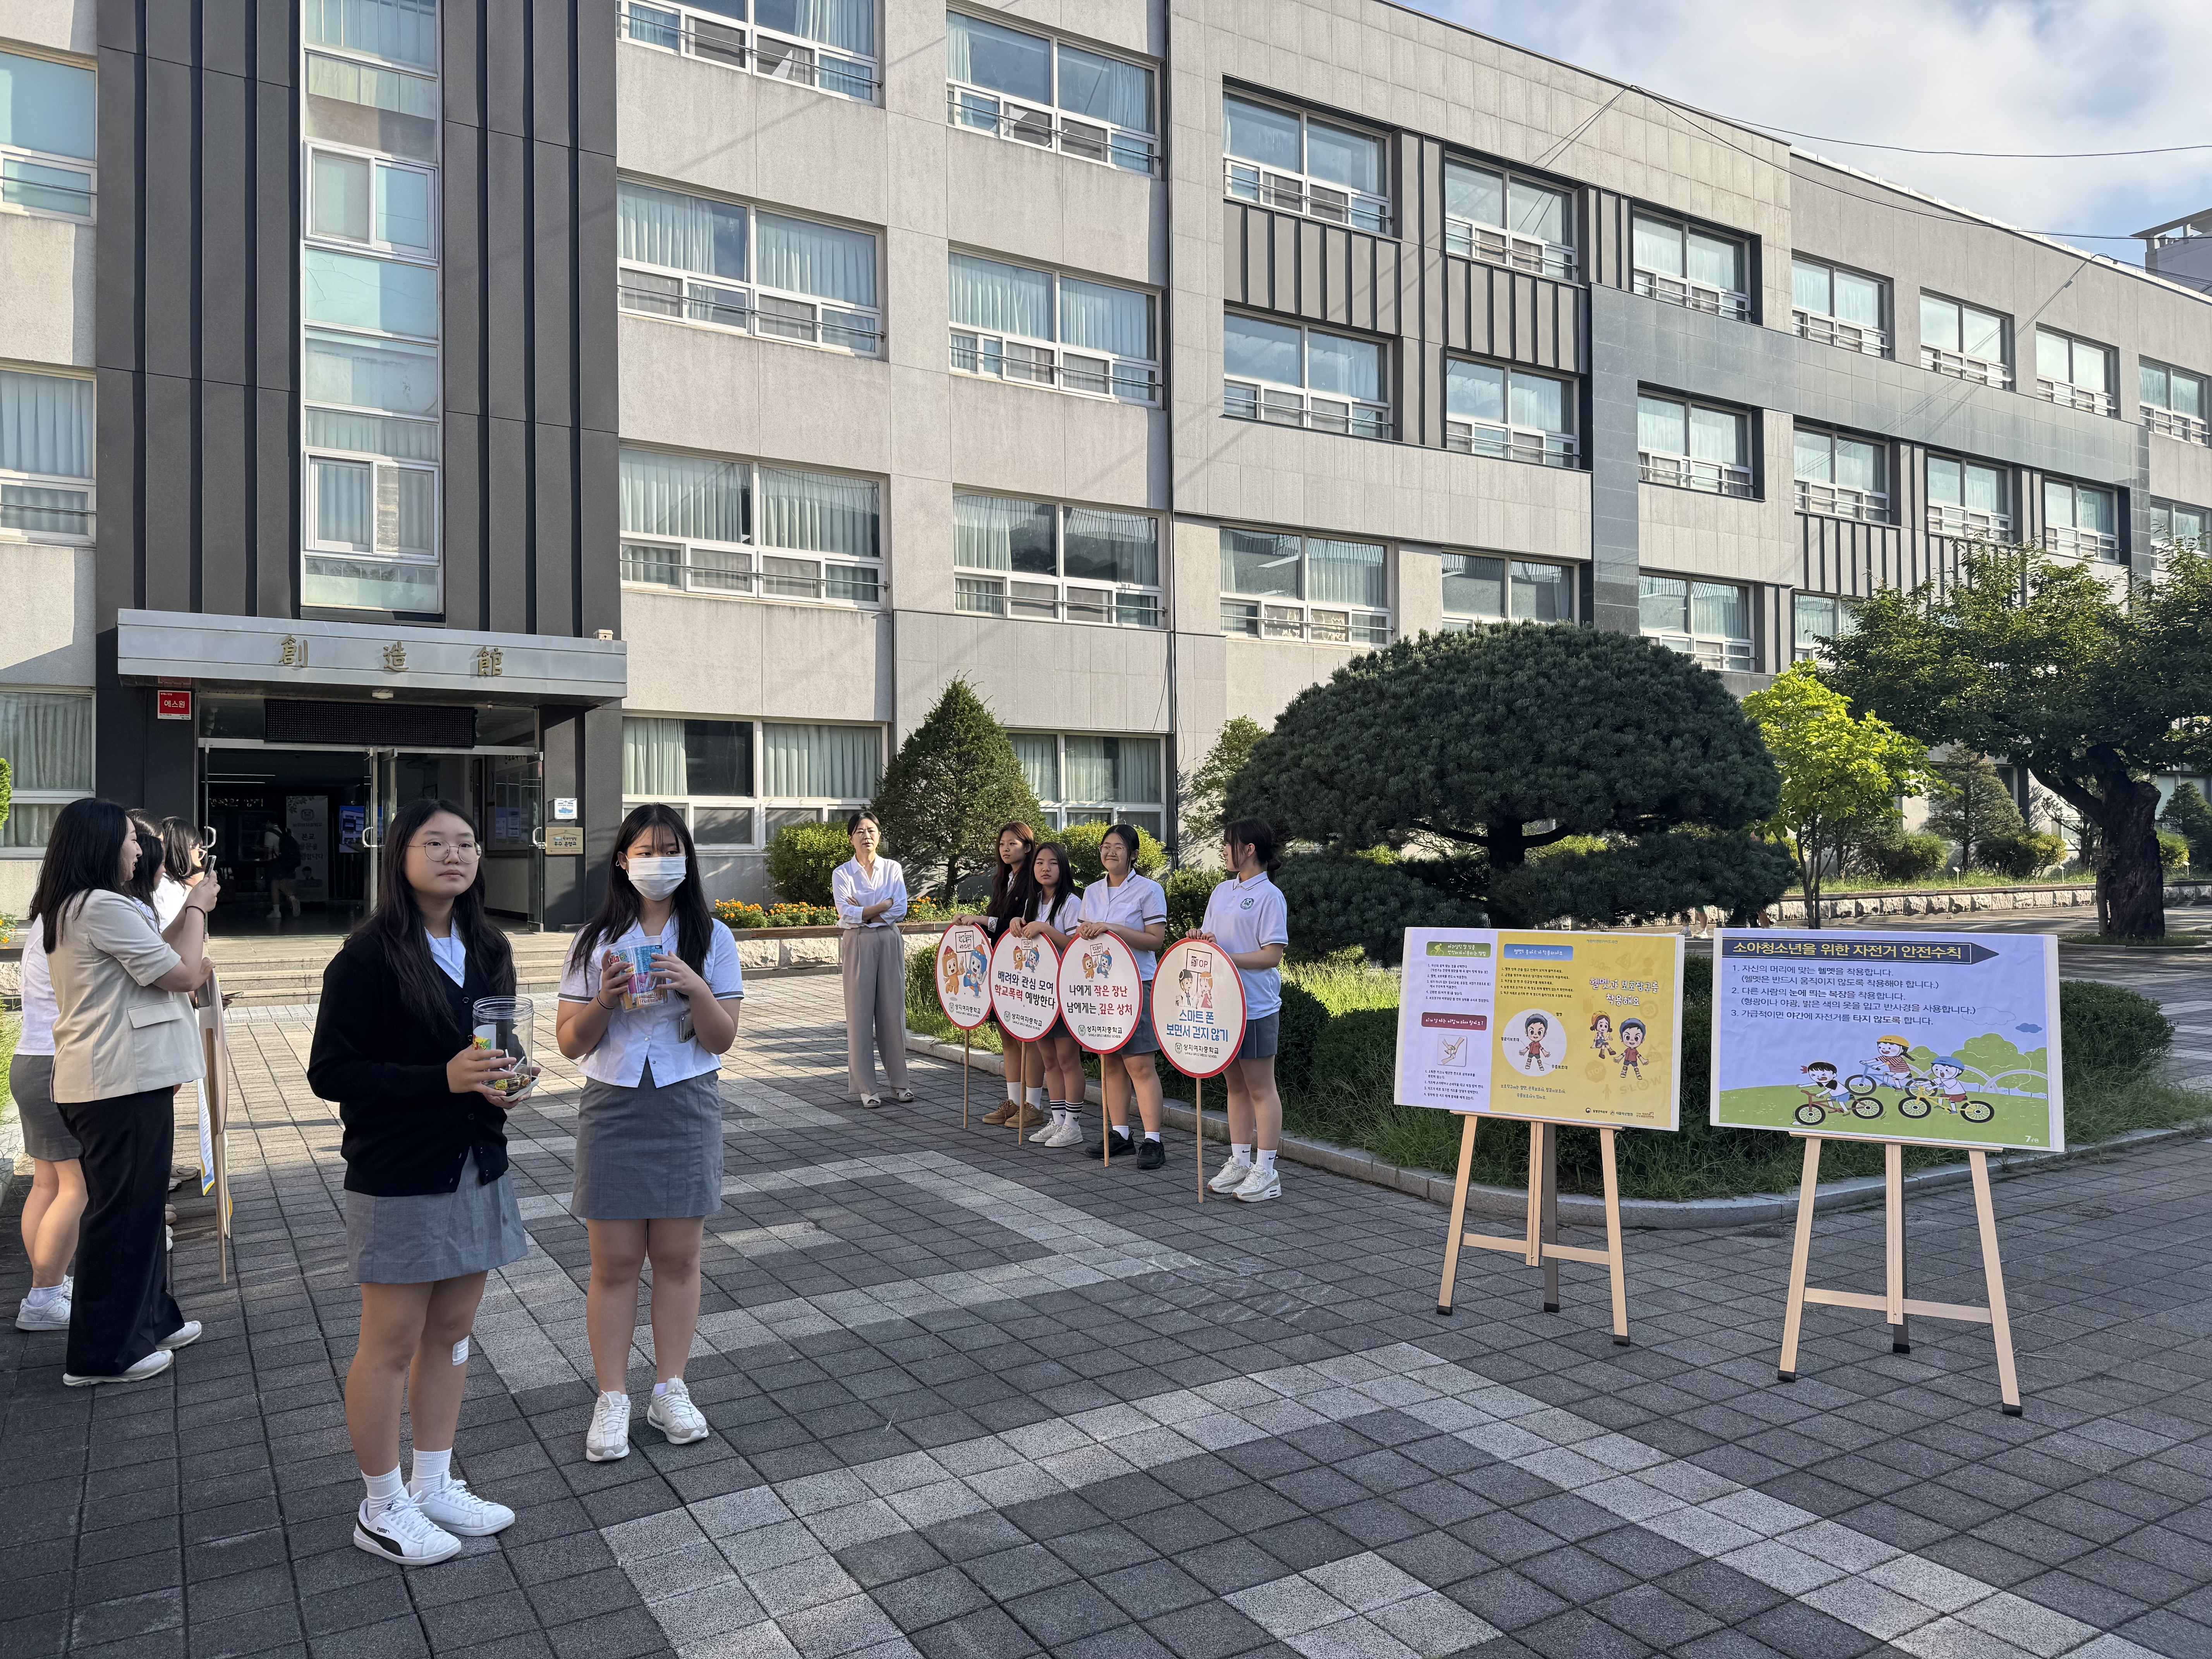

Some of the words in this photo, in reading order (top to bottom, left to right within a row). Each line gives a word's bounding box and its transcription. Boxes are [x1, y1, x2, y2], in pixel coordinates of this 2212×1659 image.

[279, 634, 503, 677] 創造館
[1733, 942, 1817, 955] 소아청소년을
[1820, 944, 1850, 956] 위한
[1853, 945, 1897, 958] 자전거
[1901, 946, 1961, 959] 안전수칙
[1191, 958, 1208, 968] STOP
[1770, 965, 1795, 974] 머리에
[1818, 967, 1844, 975] 헬멧을
[1846, 968, 1894, 976] 착용합니다.
[998, 970, 1019, 986] 배려와
[1022, 976, 1036, 990] 관심
[1039, 980, 1053, 994] 모여
[1589, 977, 1618, 990] 헬멧과
[1621, 980, 1659, 994] 보호장구를
[1741, 975, 1770, 983] (헬멧은
[1772, 976, 1797, 984] 반드시
[1800, 977, 1835, 986] 움직이지
[1838, 978, 1864, 987] 않도록
[1867, 979, 1903, 988] 착용해야
[1906, 981, 1939, 989] 합니다.)
[994, 984, 1023, 1001] 학교폭력
[1025, 991, 1056, 1010] 예방한다
[1070, 984, 1091, 996] 나에게
[1094, 985, 1109, 997] 작은
[1112, 986, 1127, 997] 장난
[1858, 992, 1906, 1000] 착용합니다.
[1606, 993, 1640, 1006] 착용해요
[1741, 997, 1778, 1006] (형광이나
[1843, 1001, 1860, 1010] 옷을
[1863, 1003, 1881, 1011] 입고
[1884, 1003, 1920, 1012] 반사경을
[1923, 1005, 1976, 1015] 사용합니다.)
[955, 1003, 981, 1014] 상지여자중학교
[1067, 1002, 1096, 1014] 남에게는
[1099, 1003, 1115, 1015] 깊은
[1117, 1004, 1132, 1016] 상처
[1012, 1013, 1042, 1027] 상지여자중학교
[1179, 1009, 1204, 1023] 스마트
[1206, 1011, 1214, 1024] 폰
[1741, 1010, 1784, 1019] 가급적이면
[1786, 1012, 1812, 1020] 야간에
[1815, 1013, 1850, 1022] 자전거를
[1853, 1015, 1871, 1023] 타지
[1874, 1016, 1901, 1024] 않도록
[1903, 1017, 1933, 1025] 합니다.
[1087, 1026, 1122, 1034] 상지여자중학교
[1166, 1024, 1190, 1038] 보면서
[1192, 1026, 1209, 1040] 걷지
[1211, 1028, 1228, 1042] 않기
[1183, 1044, 1219, 1054] 상지여자중학교
